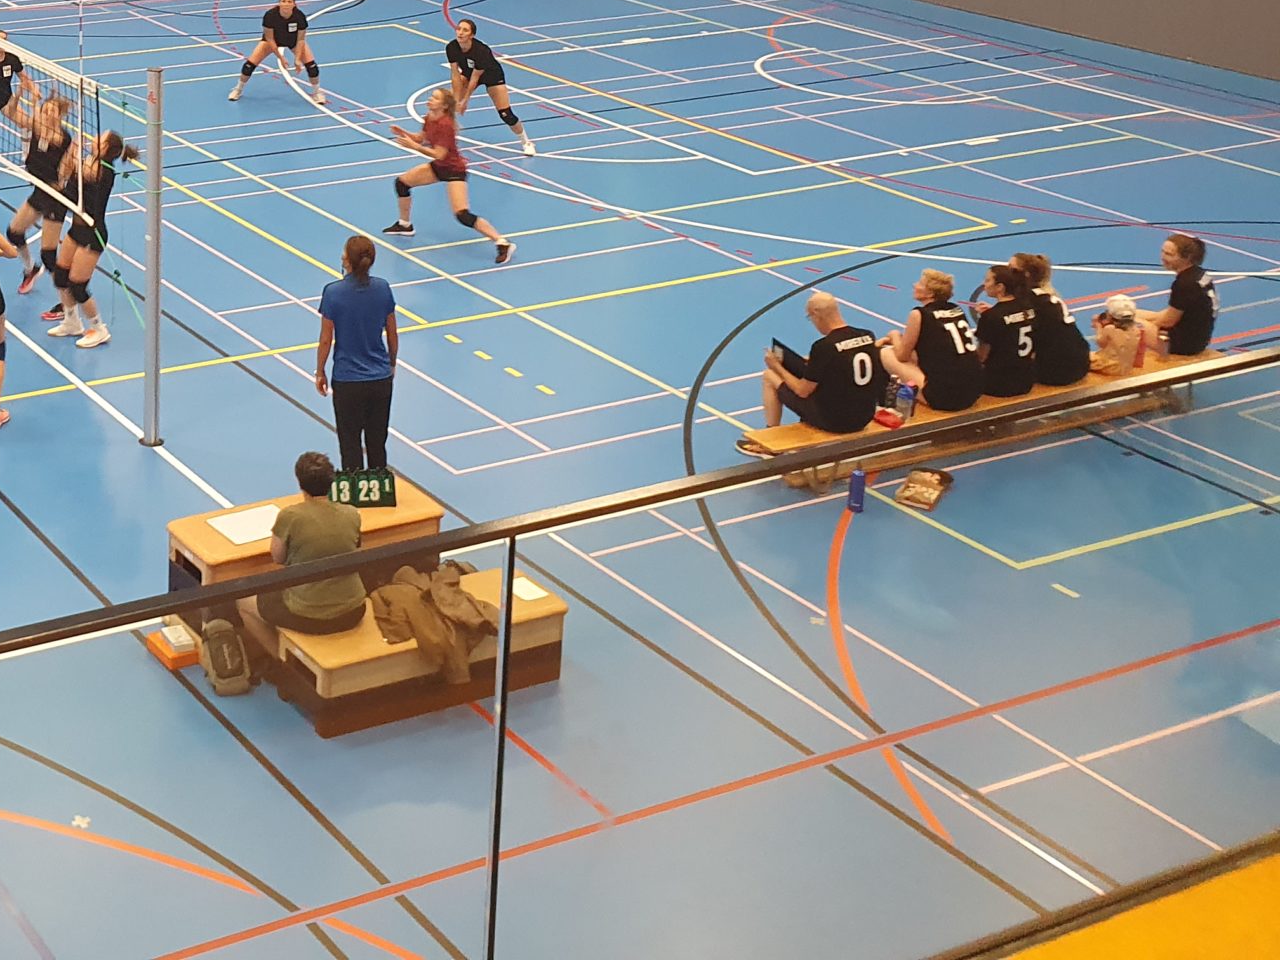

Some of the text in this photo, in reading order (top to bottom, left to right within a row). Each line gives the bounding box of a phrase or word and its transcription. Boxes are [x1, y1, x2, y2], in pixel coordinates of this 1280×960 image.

[943, 319, 979, 354] 13
[1017, 324, 1033, 357] 5
[852, 352, 873, 386] 0
[331, 480, 350, 503] 13
[358, 479, 380, 502] 23
